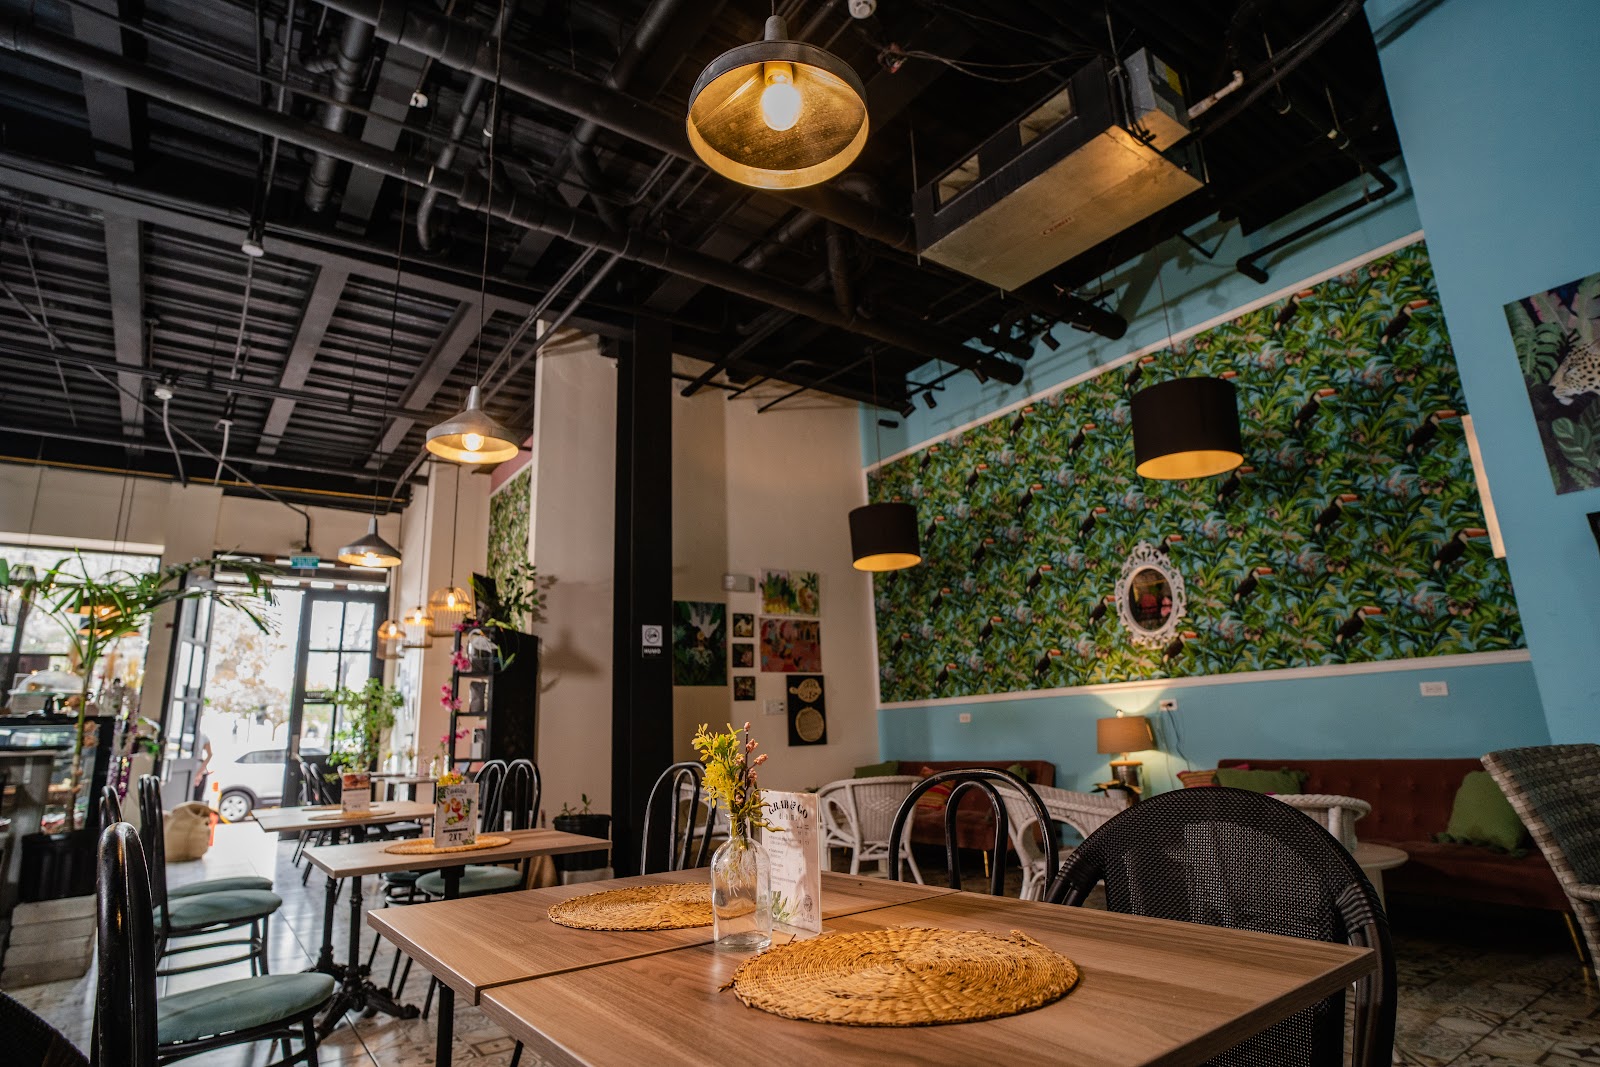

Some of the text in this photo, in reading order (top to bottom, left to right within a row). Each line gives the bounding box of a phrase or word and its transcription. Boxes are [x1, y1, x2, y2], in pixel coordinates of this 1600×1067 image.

[768, 799, 789, 815] GRAB
[790, 800, 797, 810] &
[797, 804, 808, 819] GO
